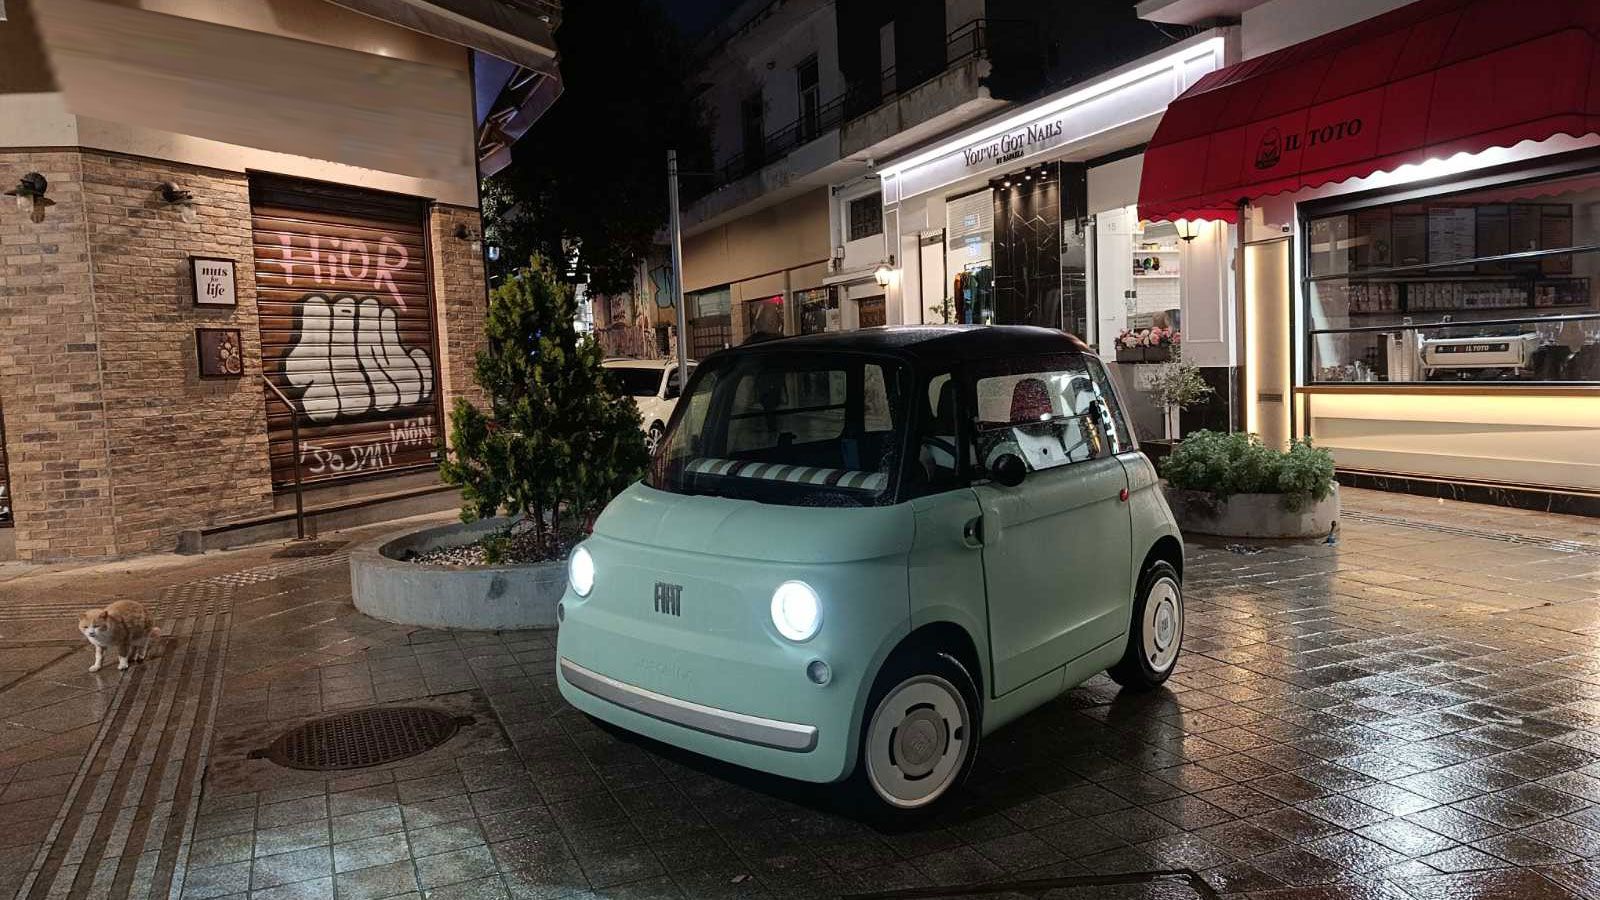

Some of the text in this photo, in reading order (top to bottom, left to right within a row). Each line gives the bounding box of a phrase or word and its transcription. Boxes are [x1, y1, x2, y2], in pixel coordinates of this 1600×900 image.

[963, 120, 1062, 167] YOU'VE GOT NAILS
[1285, 134, 1300, 152] IL
[1308, 118, 1362, 148] TOTO
[202, 267, 228, 277] nuts
[206, 283, 225, 298] life
[655, 582, 683, 617] FIAT
